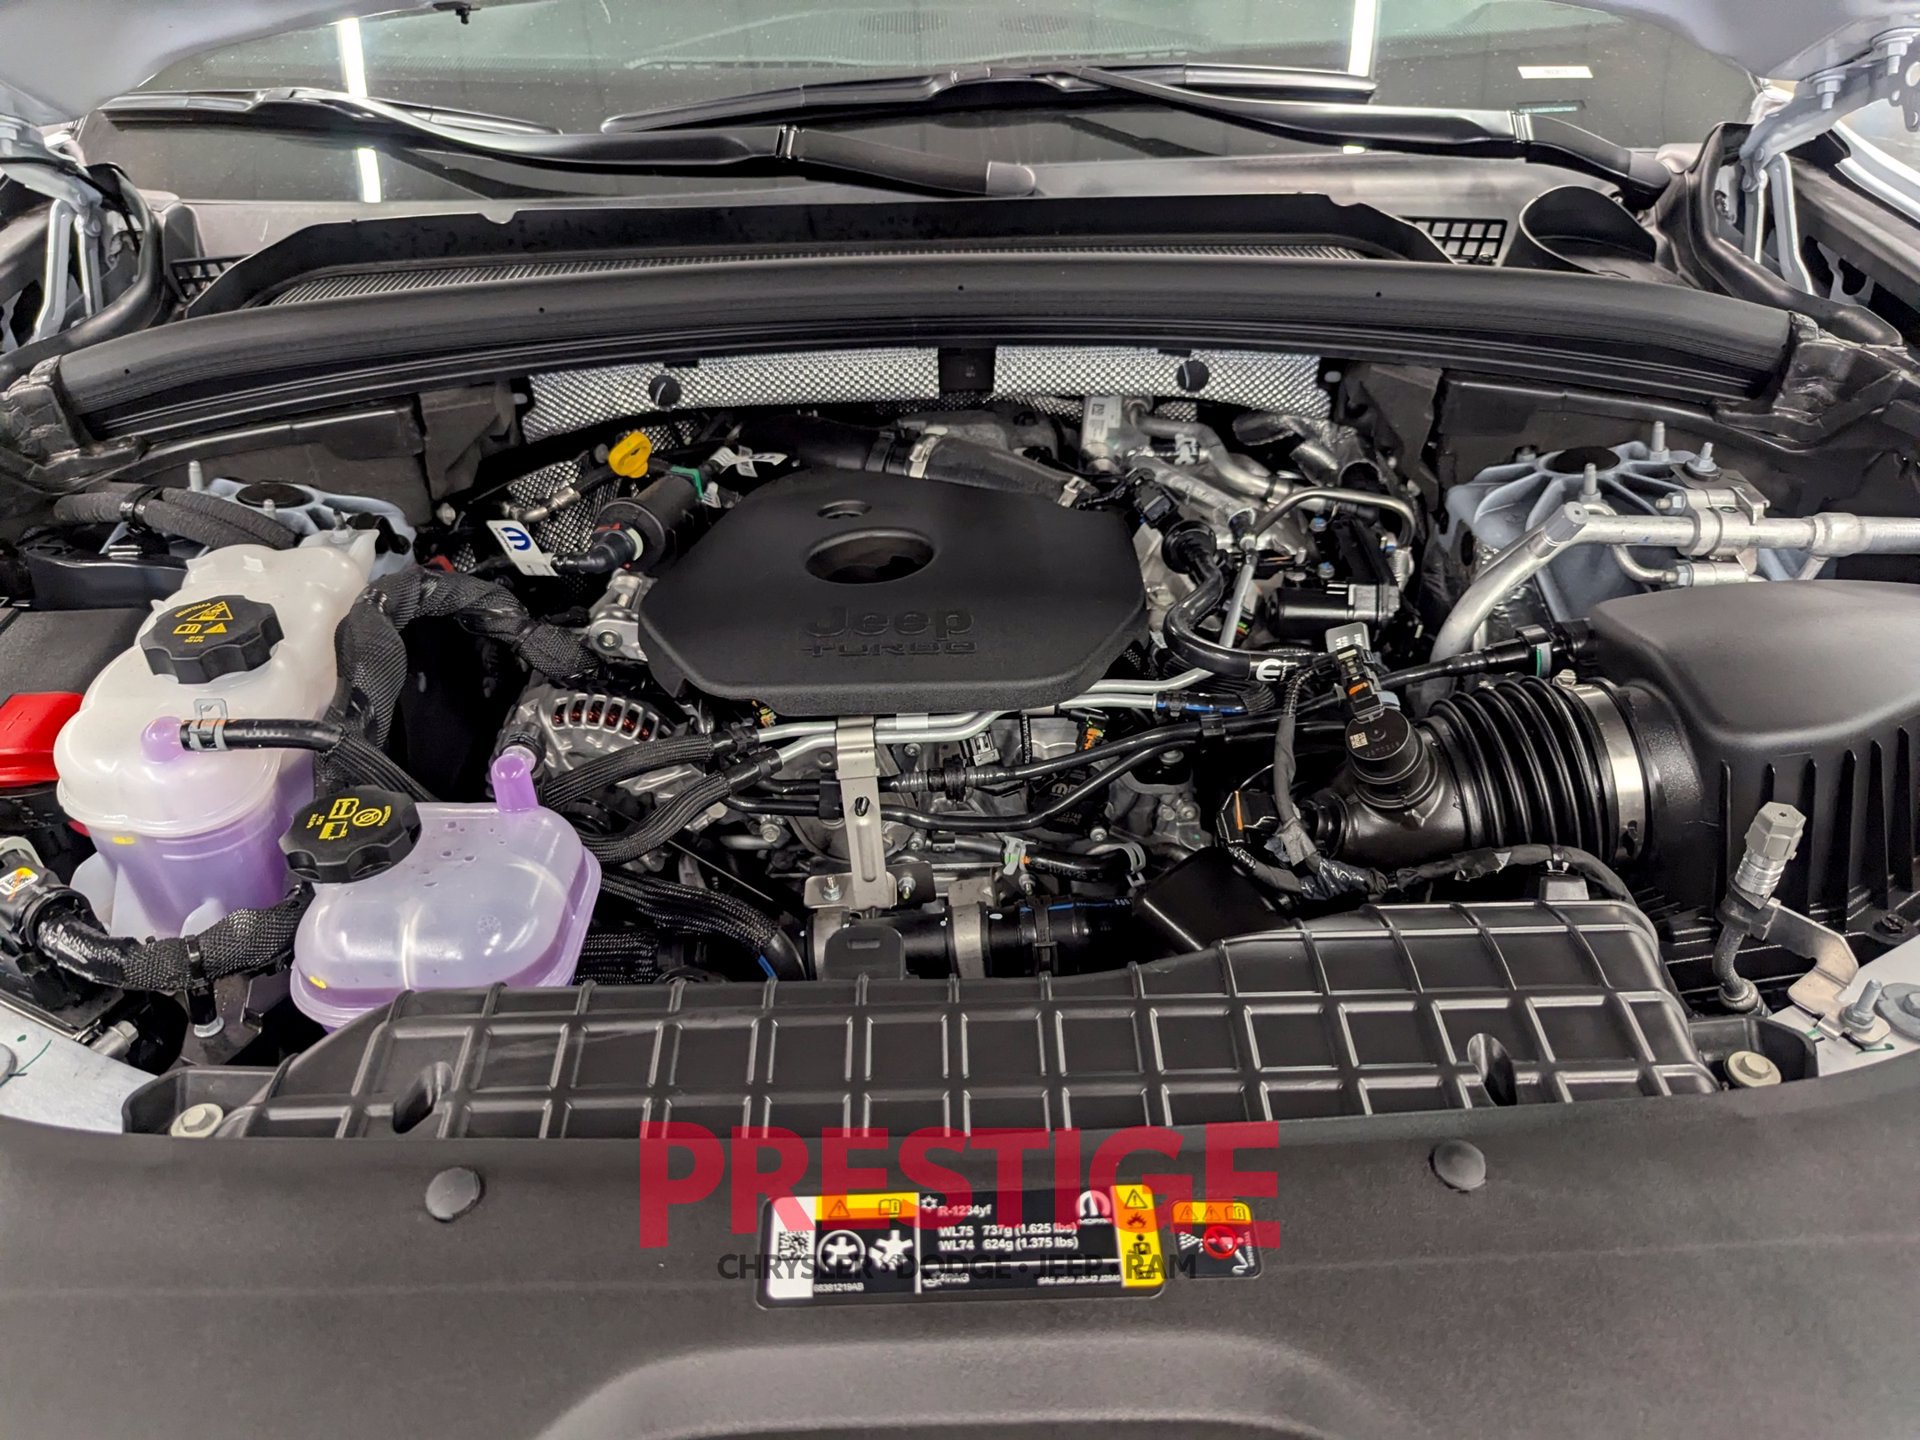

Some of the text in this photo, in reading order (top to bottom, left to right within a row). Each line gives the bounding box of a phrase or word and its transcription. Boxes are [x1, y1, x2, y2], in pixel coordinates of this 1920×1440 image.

[804, 606, 974, 642] Jeep
[802, 642, 977, 658] TURBO
[937, 1203, 992, 1218] R-1234yf
[938, 1221, 1078, 1238] WL75 737g (1.625 lbs)
[938, 1236, 1079, 1251] WL74 624g (1.375 lbs)
